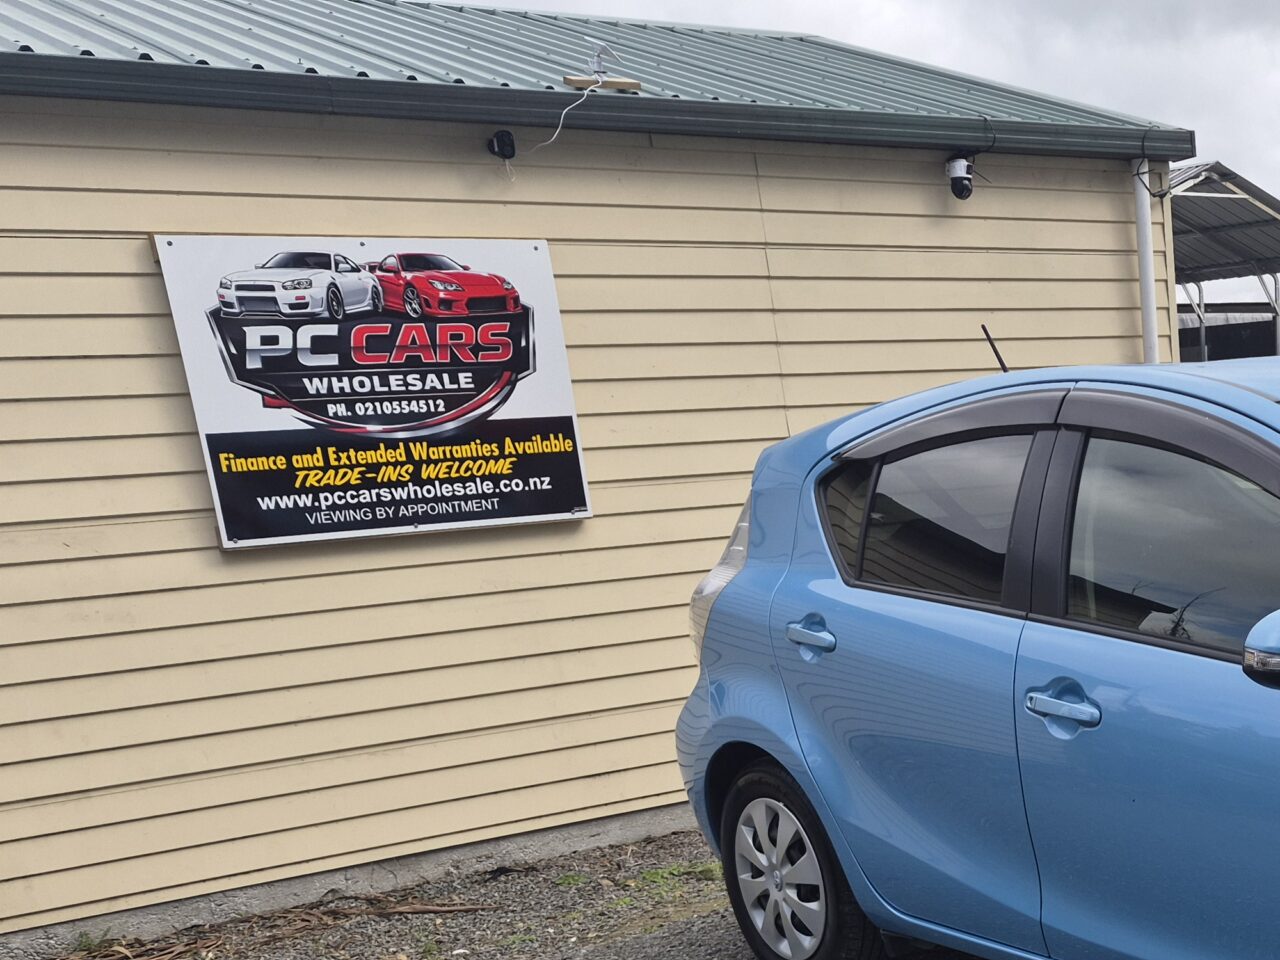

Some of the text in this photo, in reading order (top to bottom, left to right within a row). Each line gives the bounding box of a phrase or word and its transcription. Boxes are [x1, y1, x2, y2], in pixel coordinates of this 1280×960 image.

[242, 322, 513, 369] PC CARS
[302, 372, 475, 394] WHOLESALE
[327, 399, 446, 417] PH. 0210554512
[219, 433, 573, 473] Finance and Extended Warranties Available
[294, 457, 518, 489] TRADE-INS WELCOME
[257, 476, 552, 510] www.pccarswholesale.co.nz
[305, 498, 500, 525] VIEWING BY APPOINTMENT
